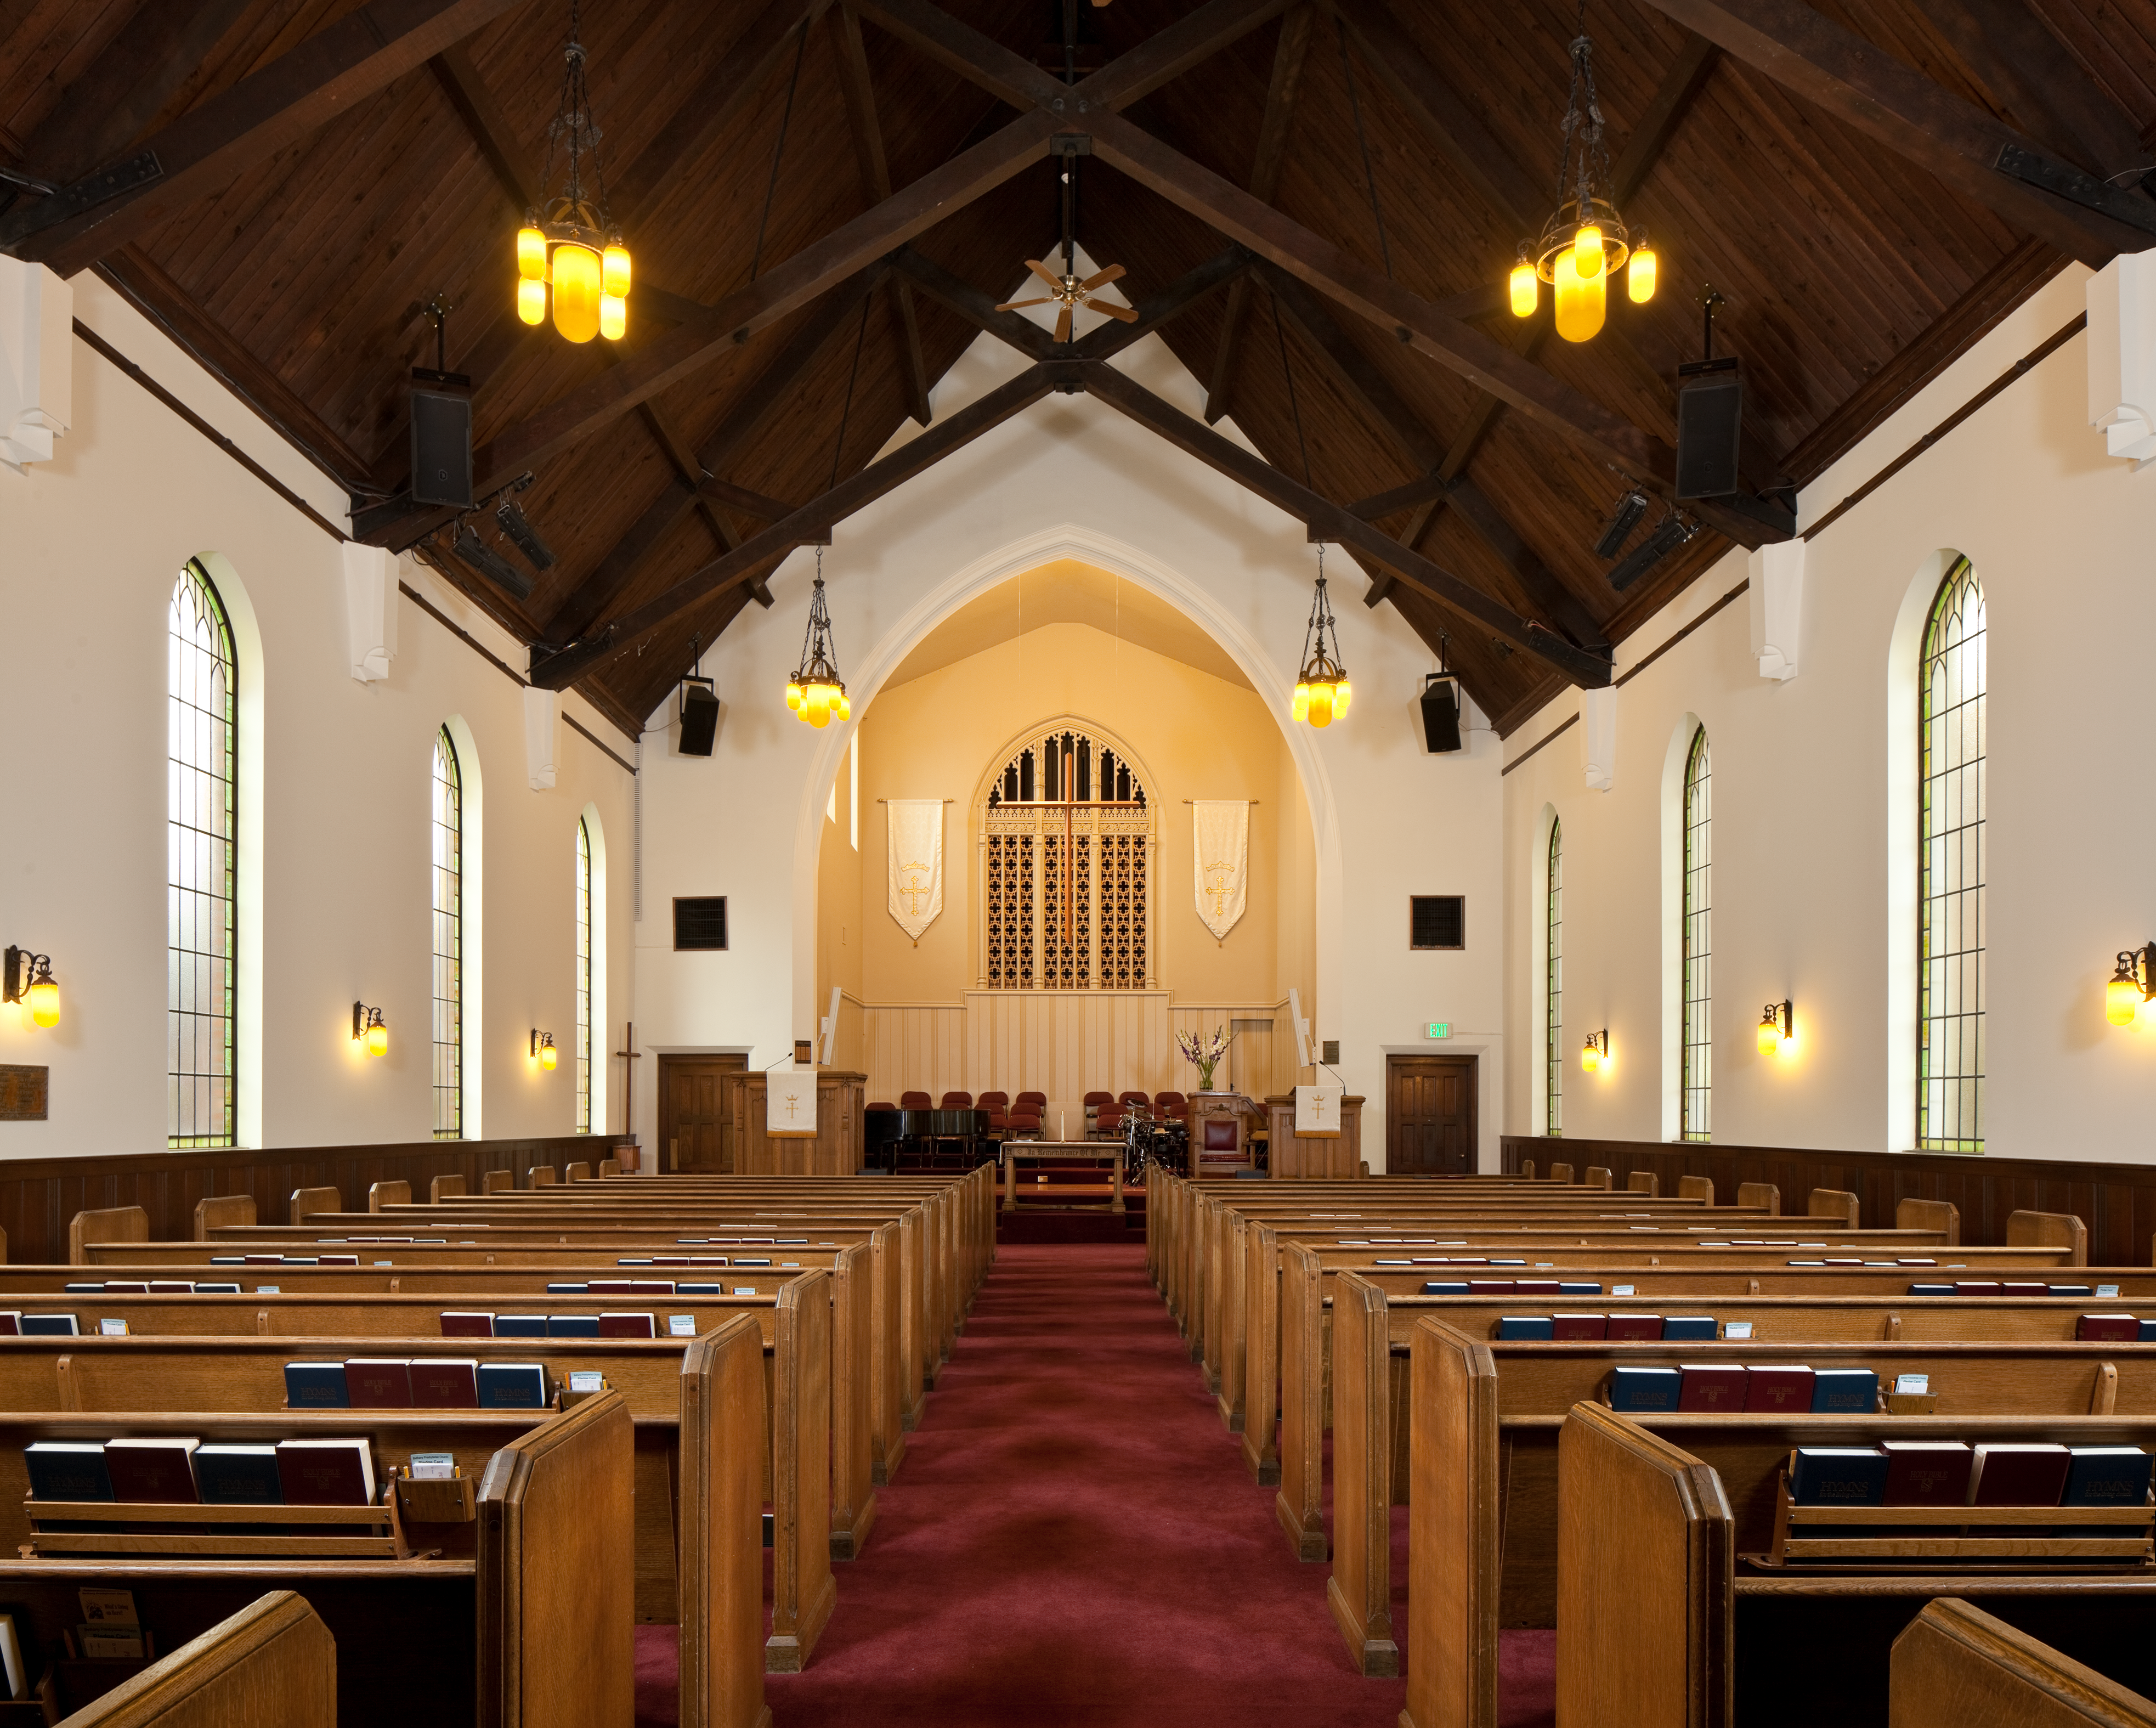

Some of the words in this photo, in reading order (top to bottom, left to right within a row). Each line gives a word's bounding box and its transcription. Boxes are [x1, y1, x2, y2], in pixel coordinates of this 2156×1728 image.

[1430, 1023, 1448, 1037] EXIT
[1080, 1148, 1089, 1156] Of
[1090, 1148, 1101, 1156] Me
[301, 1387, 336, 1396] HYMNS
[1631, 1392, 1667, 1401] HYMNS
[1828, 1394, 1865, 1403] HYMNS
[48, 1477, 95, 1487] HYMNS
[217, 1479, 265, 1489] HYMNS
[1820, 1482, 1869, 1492] HYMNS
[2086, 1481, 2134, 1491] HYMNS
